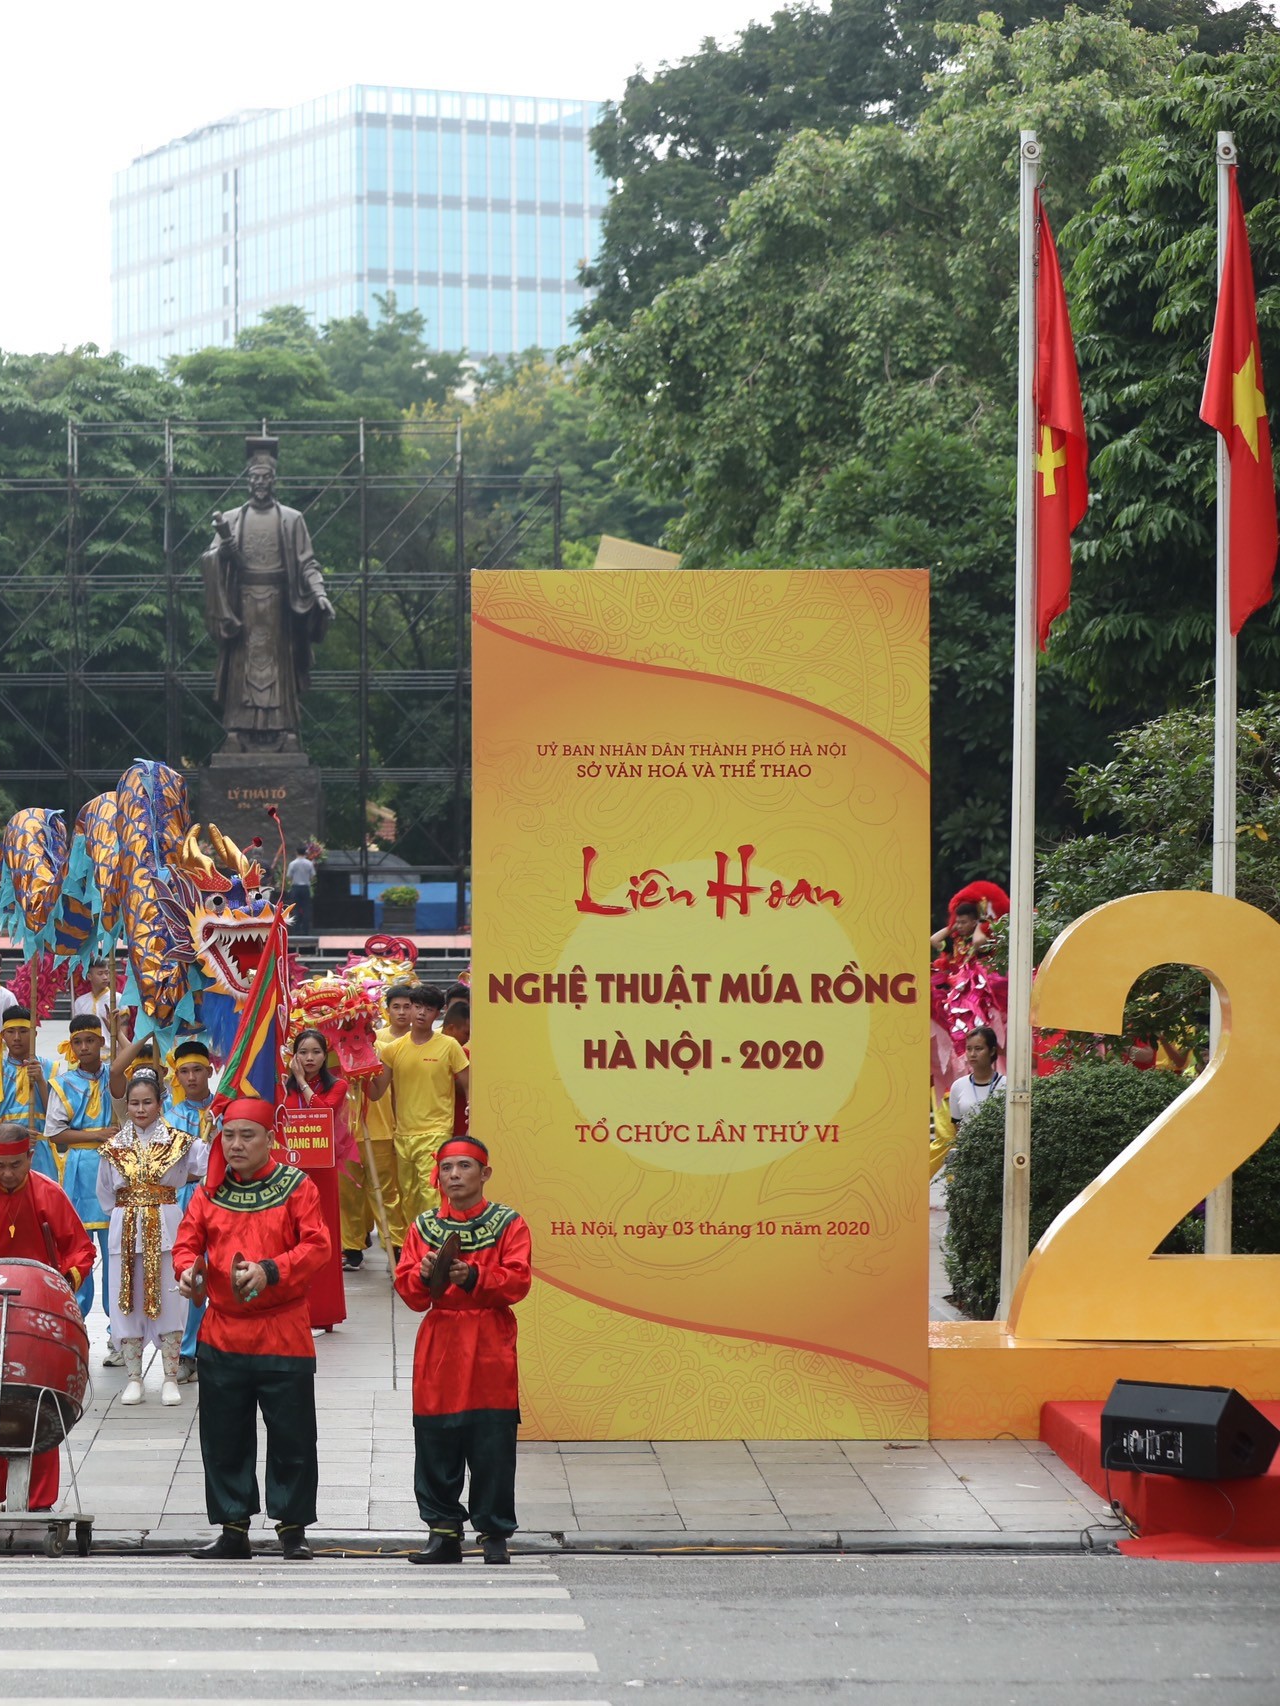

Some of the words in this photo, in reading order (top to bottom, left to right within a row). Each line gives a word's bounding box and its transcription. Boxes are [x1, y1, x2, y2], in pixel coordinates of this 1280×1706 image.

[537, 741, 558, 757] UỶ
[562, 744, 595, 757] BAN
[600, 742, 647, 757] NHÂN
[651, 741, 685, 757] DÂN
[689, 739, 747, 757] THÀNH
[752, 740, 786, 757] PHỐ
[790, 741, 813, 756] HÀ
[816, 741, 846, 759] NỘI
[576, 760, 604, 778] SỞ
[608, 760, 644, 779] VĂN
[647, 759, 686, 779] HOÁ
[692, 760, 716, 778] VÀ
[720, 758, 757, 778] THỂ
[762, 764, 812, 778] THAO
[575, 846, 697, 917] Liên
[706, 844, 844, 921] Hoan
[488, 964, 590, 1010] NGHỆ
[594, 964, 713, 1010] THUẬT
[719, 964, 804, 1005] MÚA
[810, 961, 919, 1005] RỒNG
[583, 1030, 638, 1070] HÀ
[645, 1030, 714, 1076] NỘI
[720, 1056, 732, 1064] -
[739, 1040, 825, 1070] 2020
[575, 1117, 610, 1143] TỔ
[616, 1120, 691, 1143] CHỨC
[696, 1118, 748, 1143] LẦN
[753, 1119, 809, 1143] THỨ
[814, 1124, 840, 1143] VI
[287, 1136, 310, 1149] OÀNG
[312, 1137, 329, 1149] MAI
[551, 1221, 577, 1236] Hà
[581, 1221, 618, 1240] Nội,
[623, 1221, 668, 1240] ngày
[673, 1222, 694, 1236] 03
[699, 1220, 753, 1240] tháng
[757, 1222, 777, 1236] 10
[781, 1222, 822, 1236] năm
[827, 1221, 870, 1236] 2020
